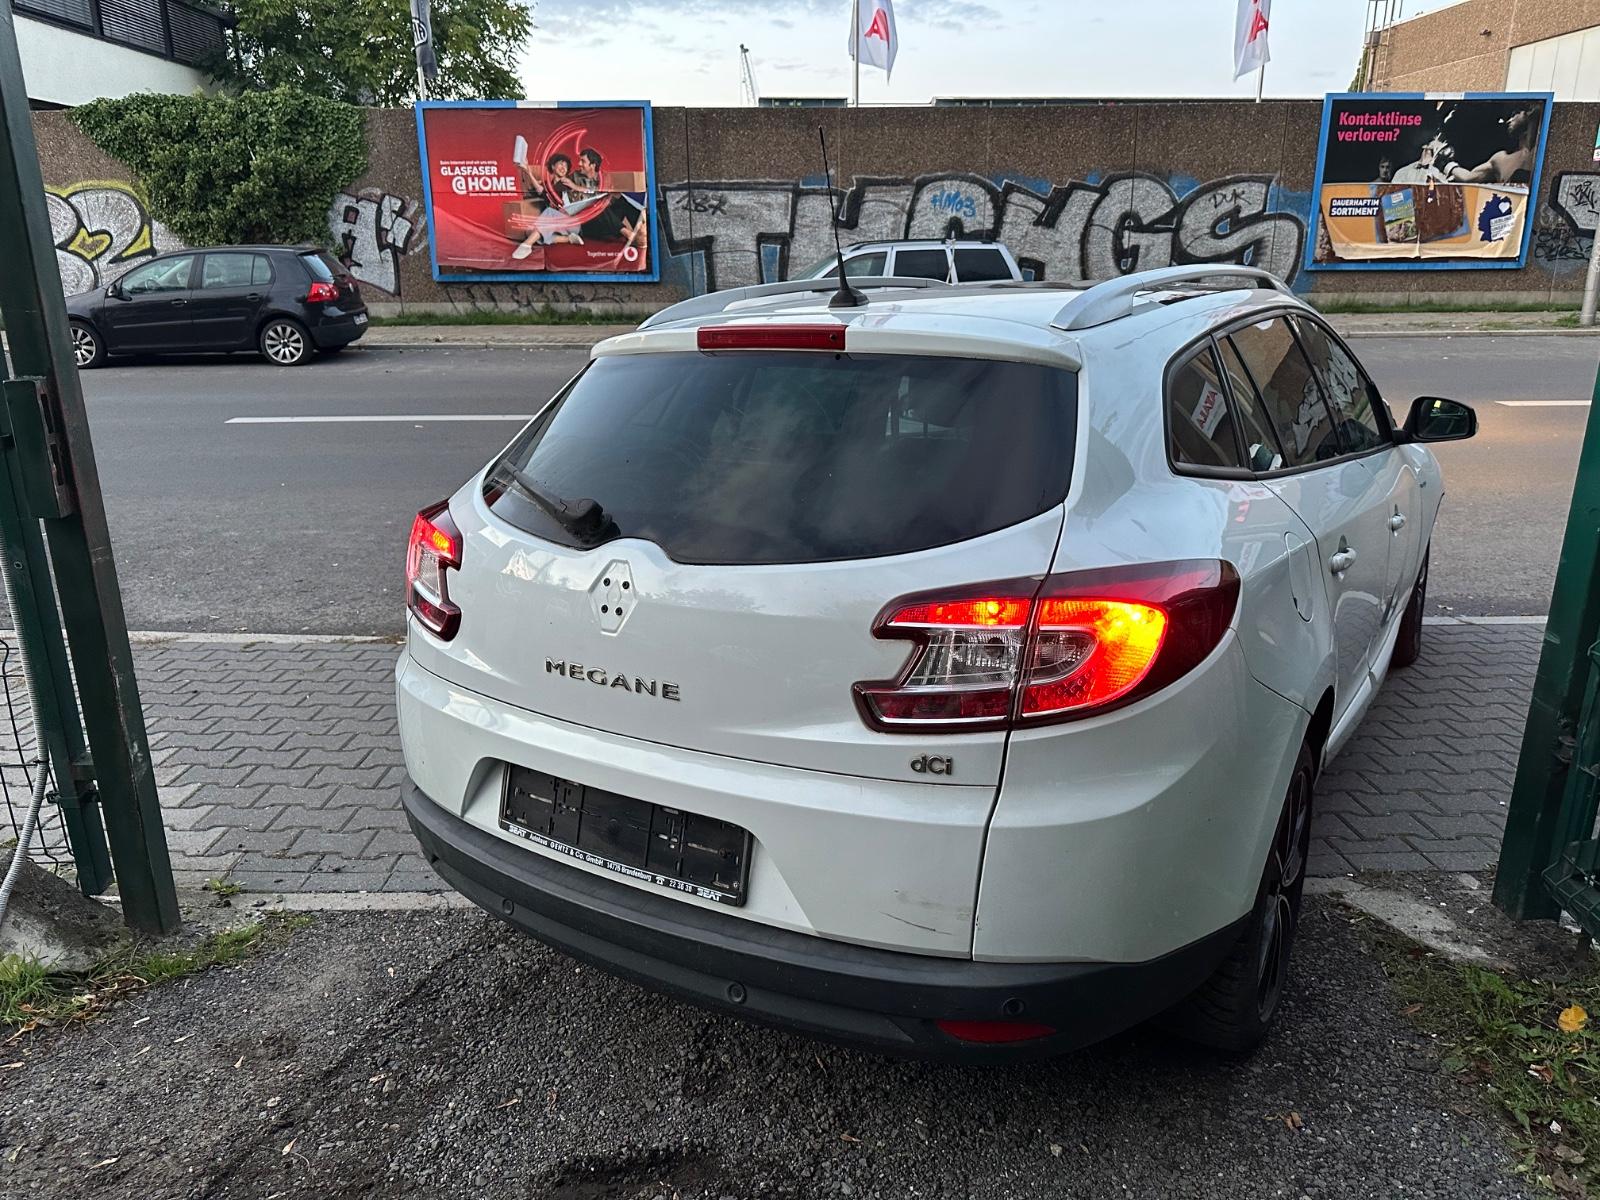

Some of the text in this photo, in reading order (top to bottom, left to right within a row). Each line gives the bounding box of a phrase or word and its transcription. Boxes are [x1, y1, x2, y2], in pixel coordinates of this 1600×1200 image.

[1339, 112, 1422, 126] Kontaktlinse
[1337, 128, 1400, 141] verloren?
[440, 165, 498, 176] GLASFASER
[452, 176, 517, 195] @HOME
[1331, 207, 1379, 216] SORTIMENT
[545, 656, 681, 702] MEGANE
[910, 753, 953, 775] dCi
[508, 824, 527, 838] SEAT
[575, 850, 585, 860] Co.
[585, 854, 604, 867] GmbH
[621, 866, 652, 882] Brandenburg
[696, 887, 722, 902] SEAT
